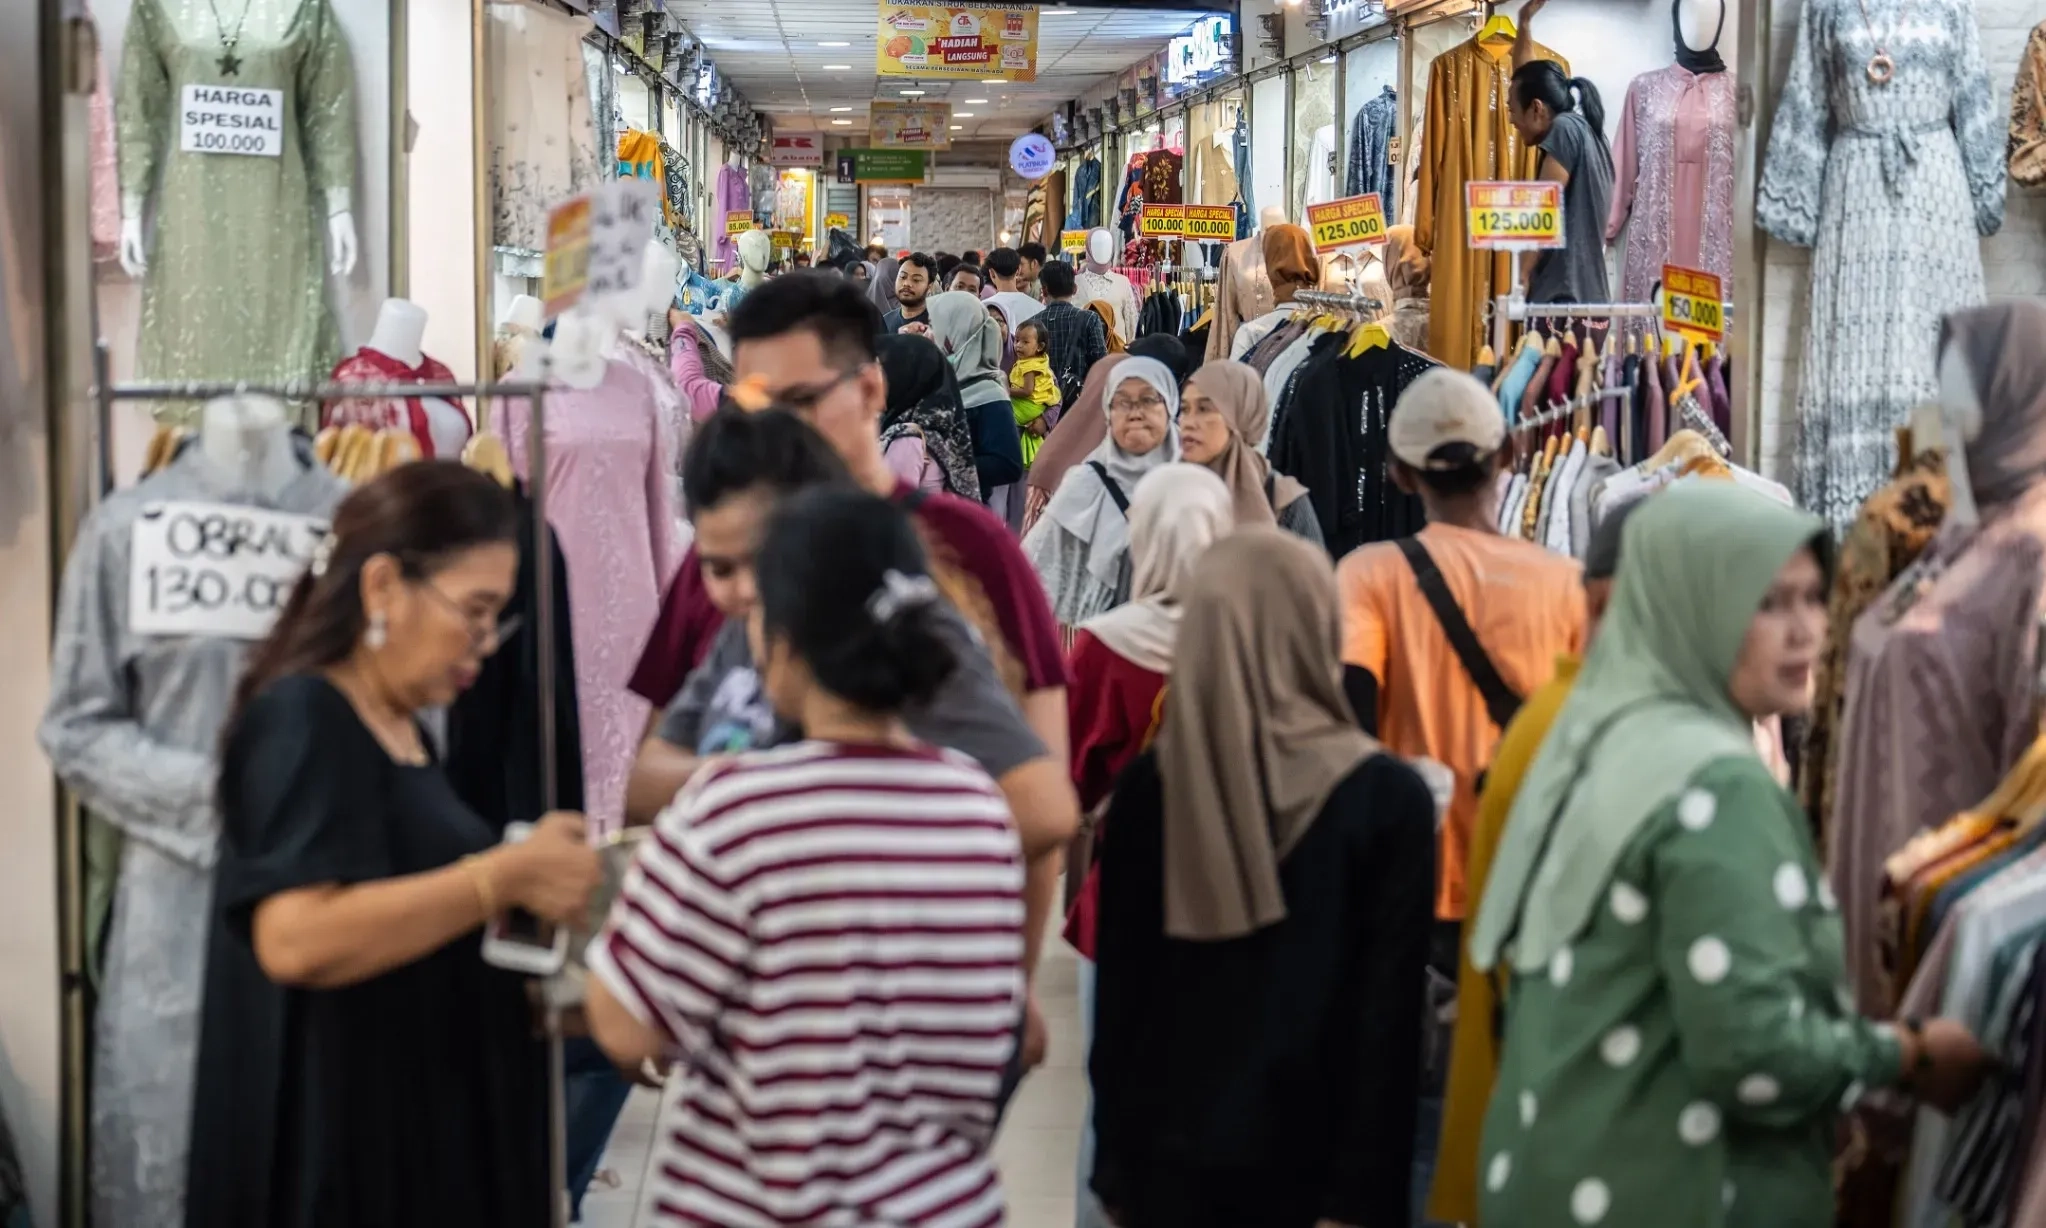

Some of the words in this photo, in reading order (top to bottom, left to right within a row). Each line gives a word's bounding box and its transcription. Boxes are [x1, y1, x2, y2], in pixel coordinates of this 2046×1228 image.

[947, 51, 988, 61] LANGSUNG
[194, 88, 272, 107] HARGA
[185, 111, 279, 131] SPESIAL
[193, 132, 266, 152] 100.000
[841, 161, 849, 175] 1
[1018, 160, 1049, 168] PLATINUM
[1146, 207, 1164, 217] HARGA
[1188, 209, 1208, 219] HARGA
[1208, 210, 1231, 220] SPECIAL
[1314, 205, 1342, 222] HARGA
[1342, 200, 1376, 217] SPECIAL
[1146, 218, 1183, 231] 100.000
[1188, 220, 1230, 234] 100.000
[1478, 212, 1553, 231] 125.000
[1317, 218, 1379, 242] 125.000
